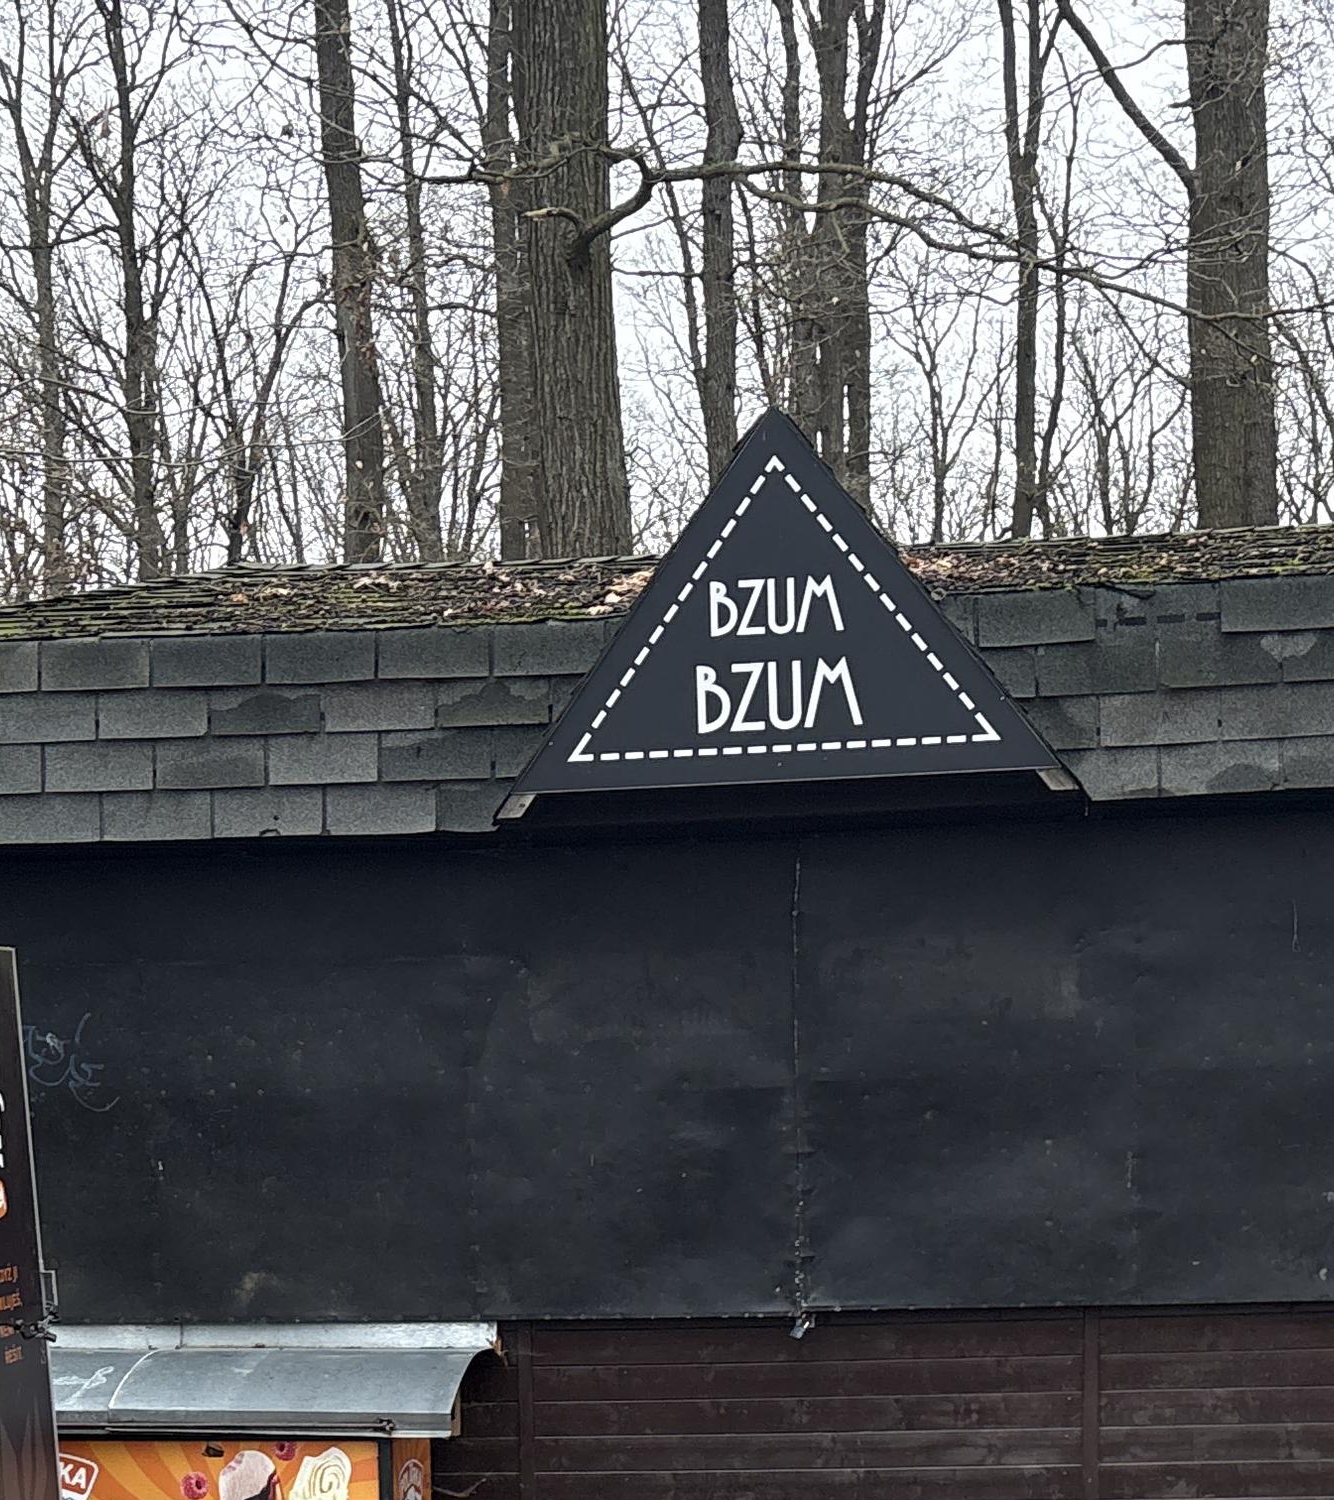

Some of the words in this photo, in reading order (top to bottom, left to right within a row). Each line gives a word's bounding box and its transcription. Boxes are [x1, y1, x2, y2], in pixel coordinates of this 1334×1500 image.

[709, 574, 845, 637] BZUM
[696, 656, 863, 734] BZUM
[59, 1461, 87, 1489] KA
